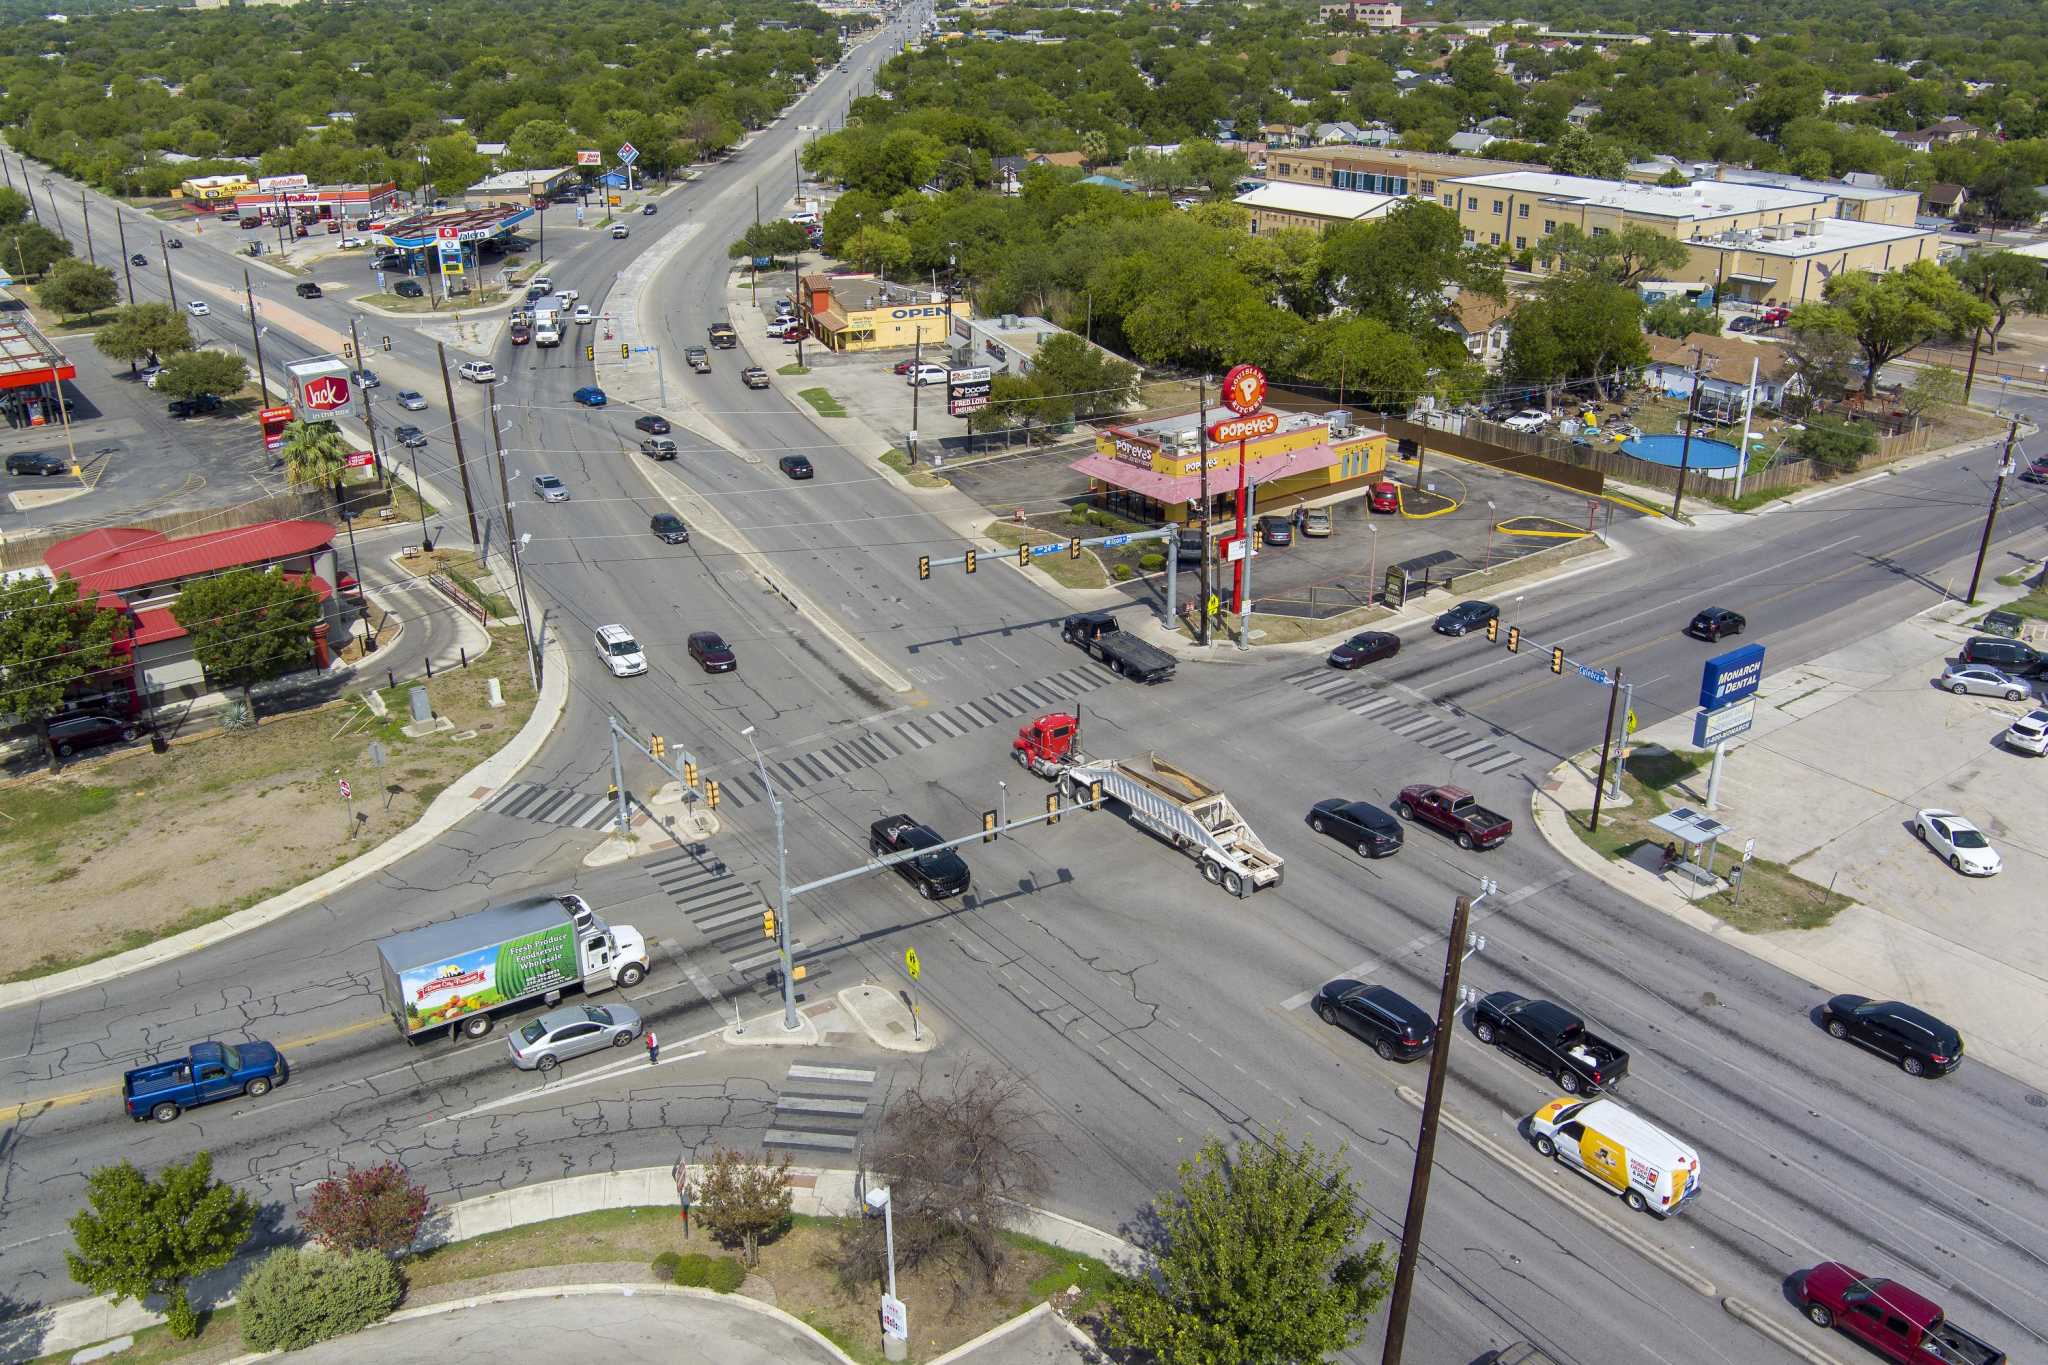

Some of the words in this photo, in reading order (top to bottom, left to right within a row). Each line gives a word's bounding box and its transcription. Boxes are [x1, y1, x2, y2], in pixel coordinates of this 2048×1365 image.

[269, 176, 305, 187] AutoZone
[892, 306, 950, 319] OPEN
[308, 380, 348, 407] Jack
[964, 384, 990, 394] boost
[1232, 394, 1264, 414] KITCHEN
[1718, 661, 1761, 684] MONARCH
[1725, 675, 1757, 694] DENTAL
[510, 944, 532, 955] Fresh
[536, 933, 567, 947] Produce
[520, 954, 562, 970] Wholesale
